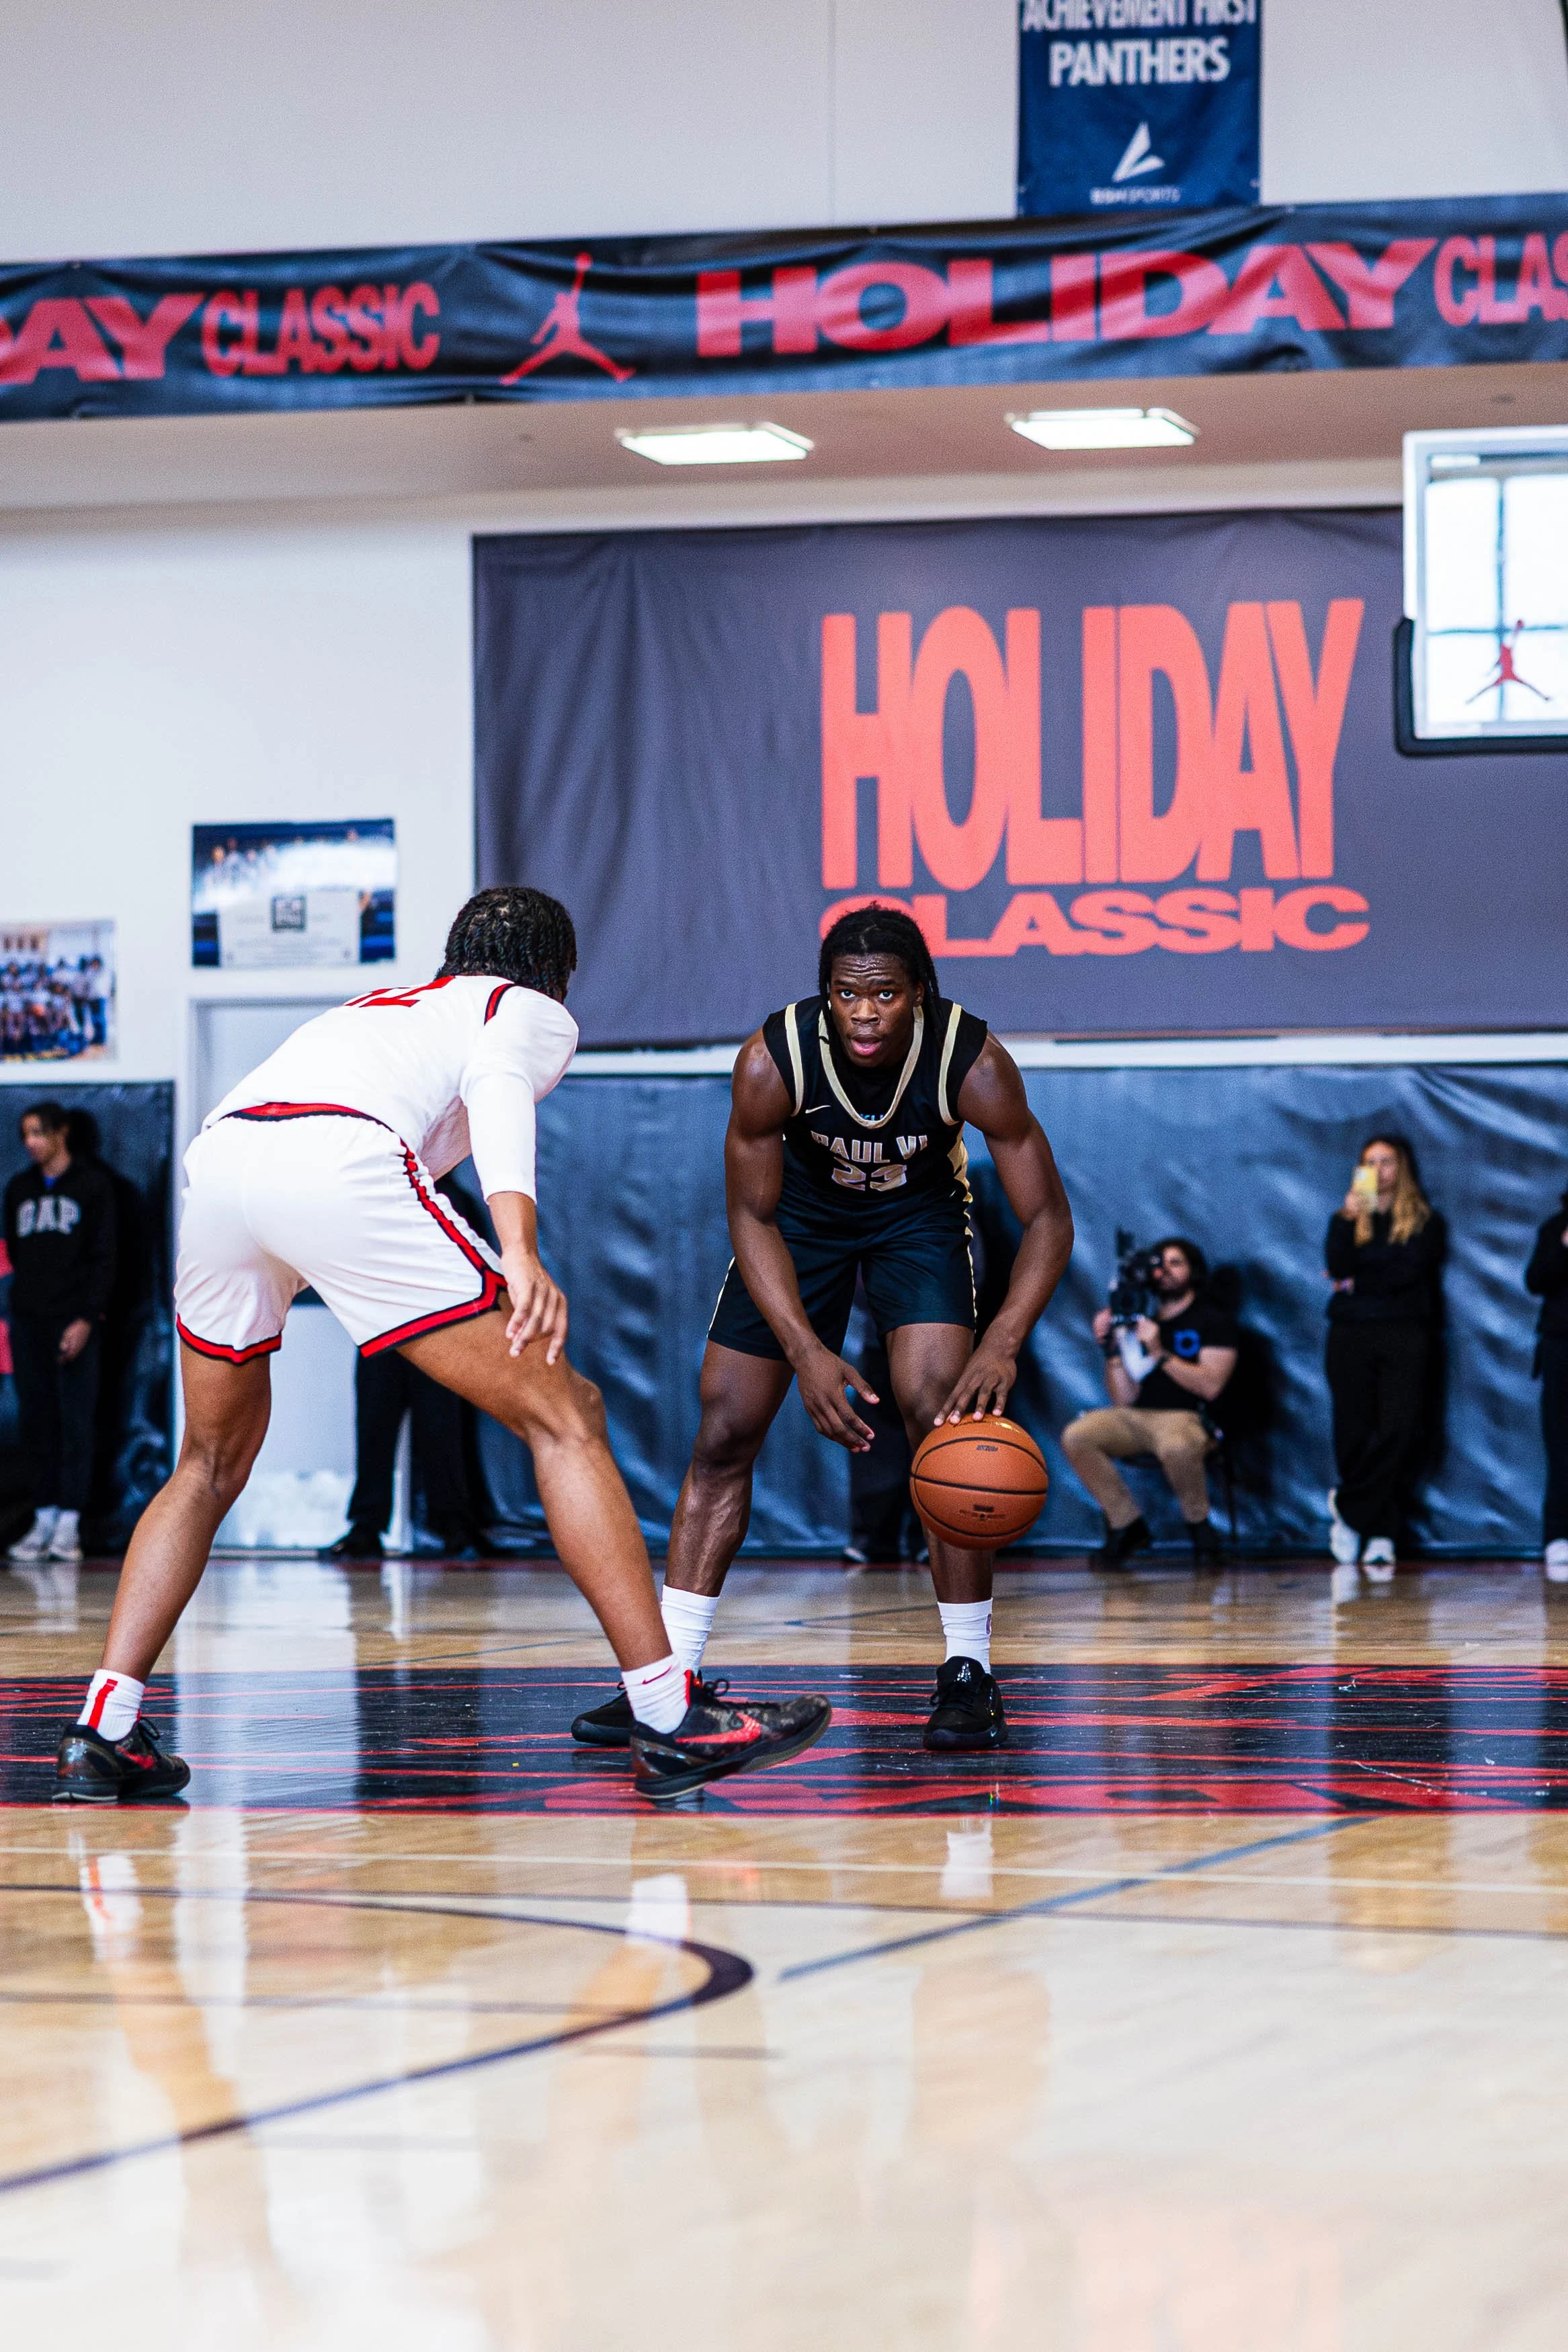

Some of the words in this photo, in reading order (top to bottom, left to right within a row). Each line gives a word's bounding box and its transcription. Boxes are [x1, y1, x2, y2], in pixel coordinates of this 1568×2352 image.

[1048, 36, 1231, 87] PANTHERS
[696, 238, 1440, 358] HOLIDAY
[0, 292, 205, 385] AY
[202, 282, 440, 376] CLASSIC
[821, 599, 1365, 891] HOLIDAY
[811, 1130, 890, 1164] PAUL
[831, 1156, 907, 1192] 23
[17, 1194, 81, 1237] GAP
